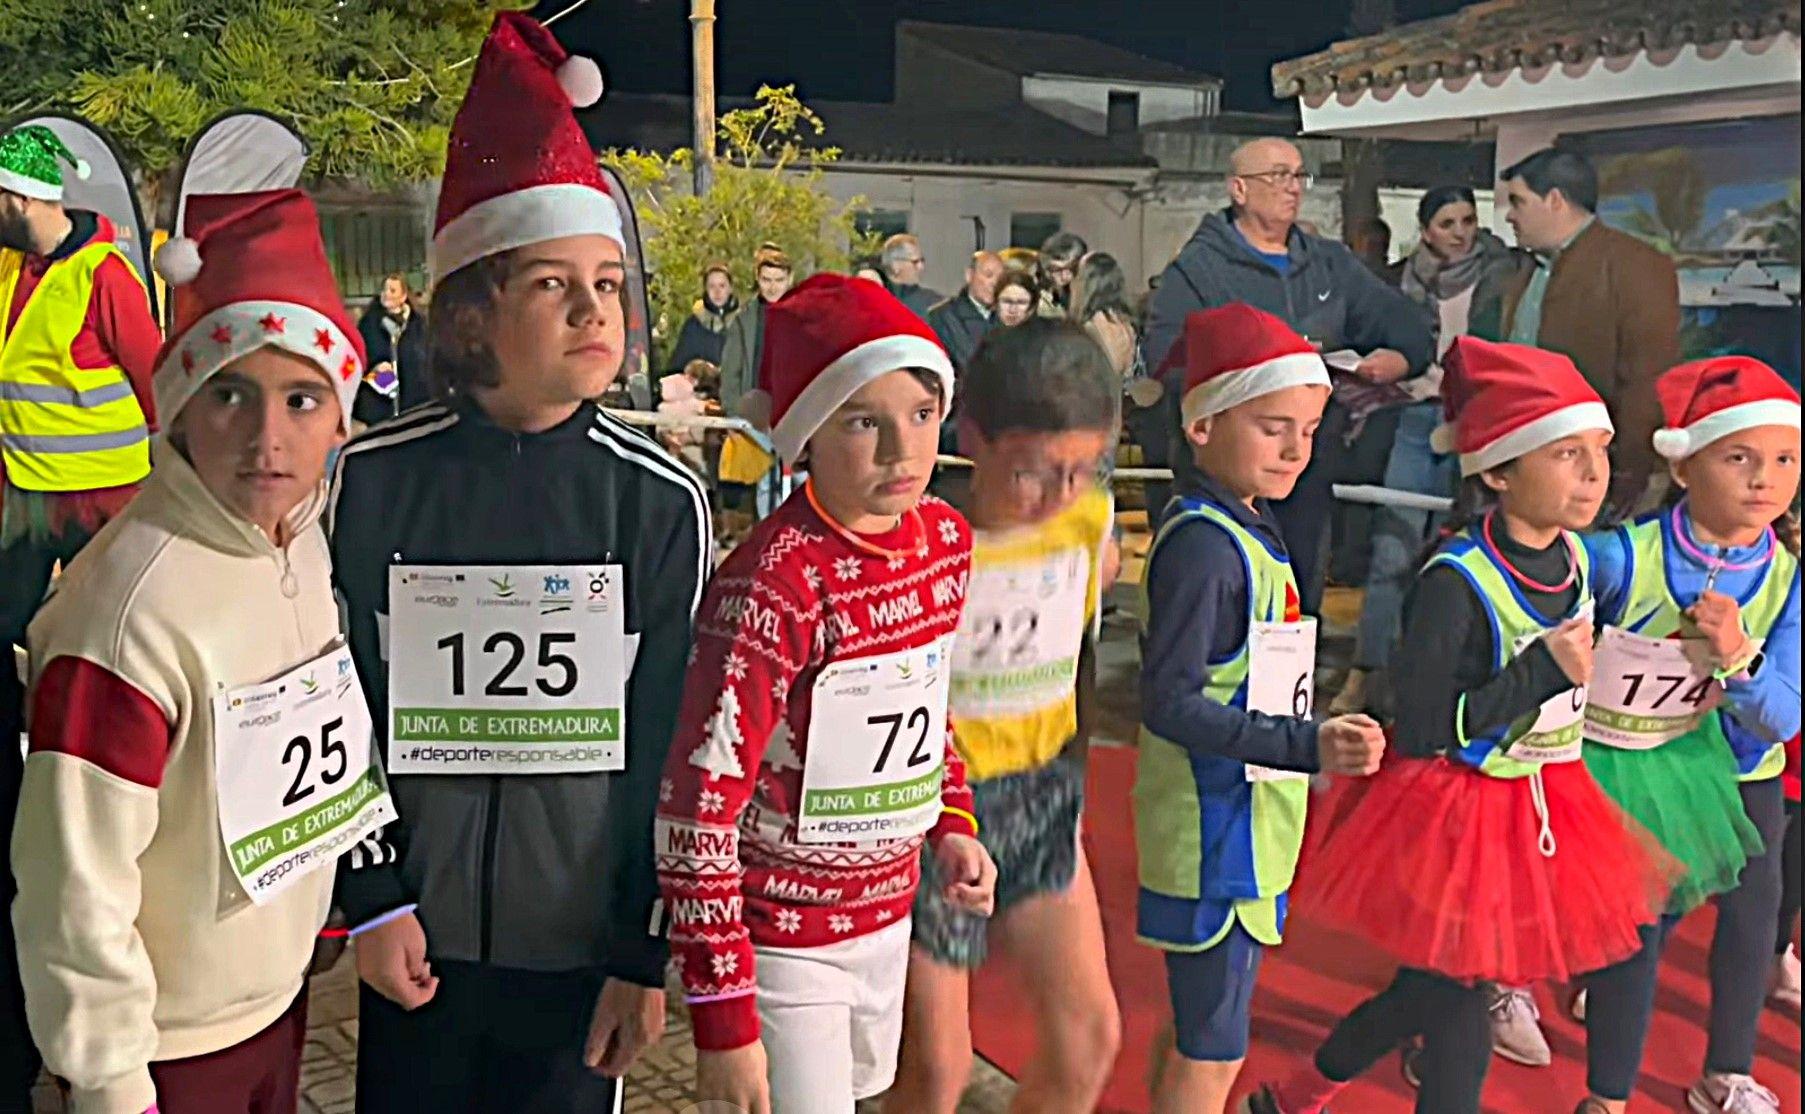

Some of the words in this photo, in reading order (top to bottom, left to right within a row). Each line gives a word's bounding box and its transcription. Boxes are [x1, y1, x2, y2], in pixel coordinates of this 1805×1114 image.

[713, 594, 781, 643] MARVEL
[437, 631, 578, 697] 125
[1621, 673, 1714, 709] 174
[400, 714, 450, 734] JUNTA
[459, 715, 479, 734] DE
[487, 716, 613, 735] EXTREMADURA
[866, 705, 931, 773] 72
[281, 715, 348, 807] 25
[410, 746, 602, 763] #deporteresponsable
[811, 794, 856, 812] JUNTA
[864, 791, 882, 809] DE
[236, 836, 275, 871] JUNTA
[281, 823, 300, 846] DE
